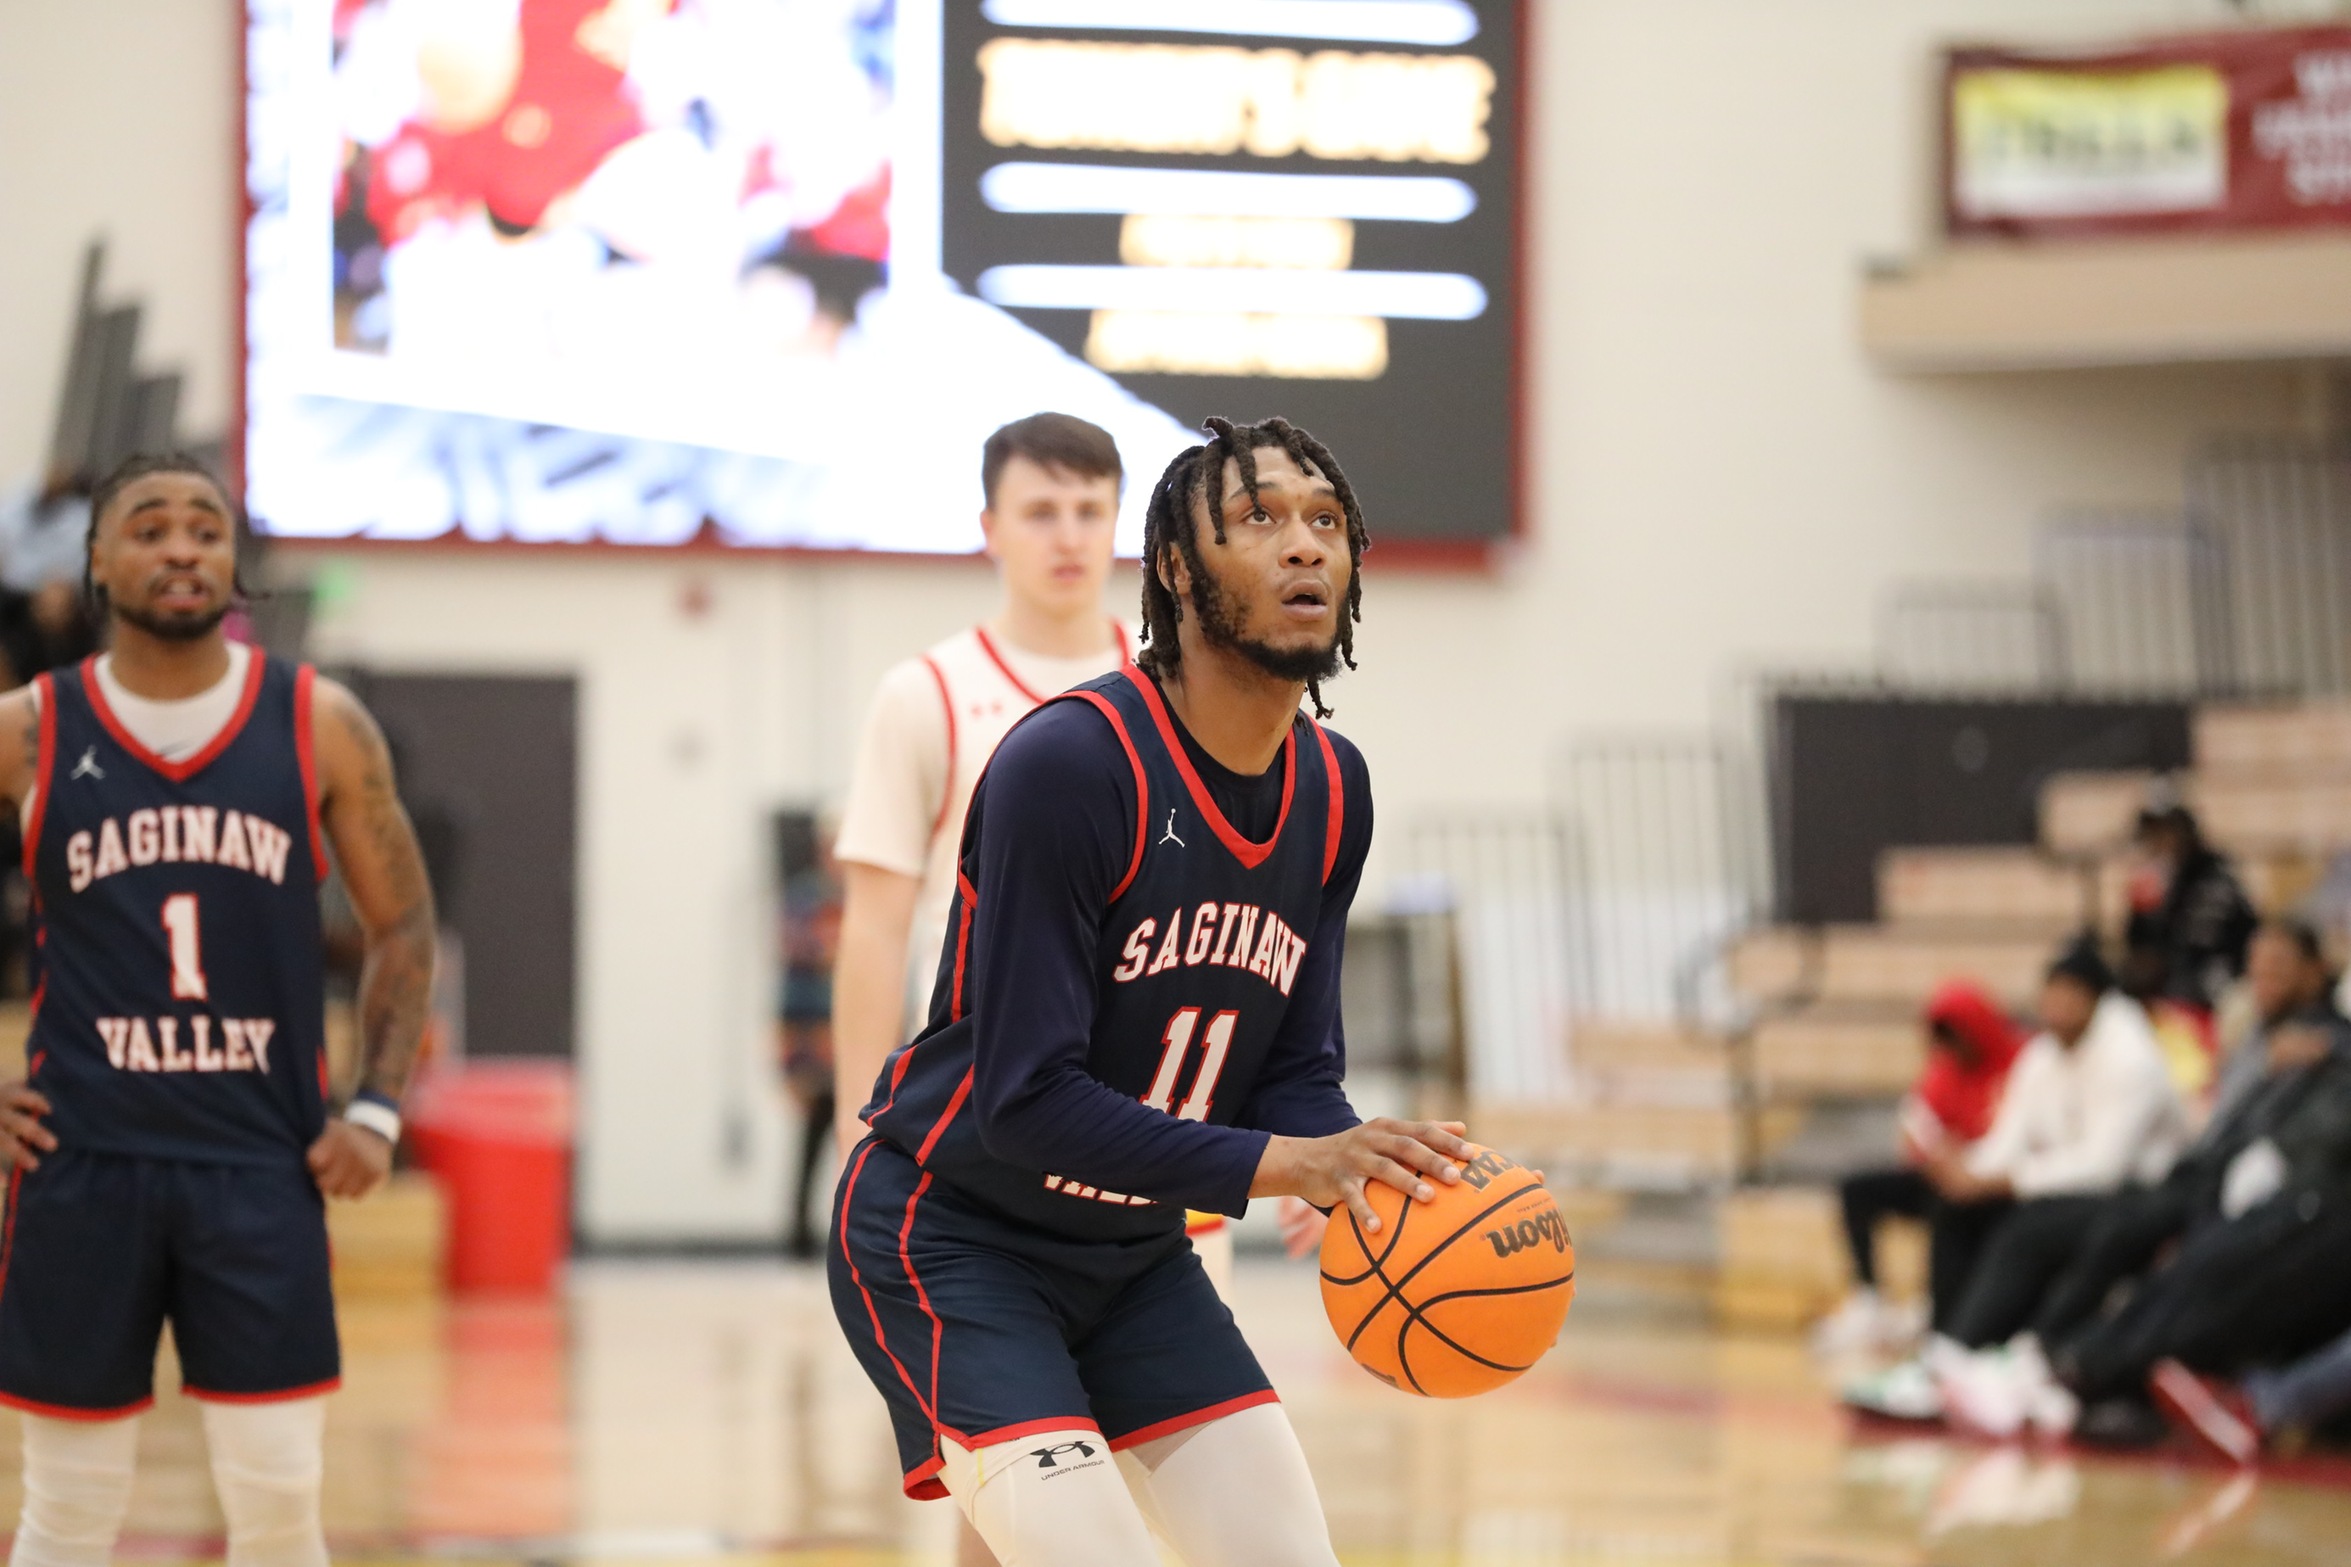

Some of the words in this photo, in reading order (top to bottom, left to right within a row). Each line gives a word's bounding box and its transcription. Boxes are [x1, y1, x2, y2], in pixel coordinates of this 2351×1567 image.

[66, 805, 292, 893] SAGINAW
[161, 893, 207, 1000] 1
[1112, 900, 1307, 998] SAGINAW
[96, 1016, 275, 1075] VALLEY
[1139, 1006, 1240, 1123] 11
[1041, 1467, 1072, 1481] UNDER
[1073, 1459, 1105, 1471] ARMOUR
